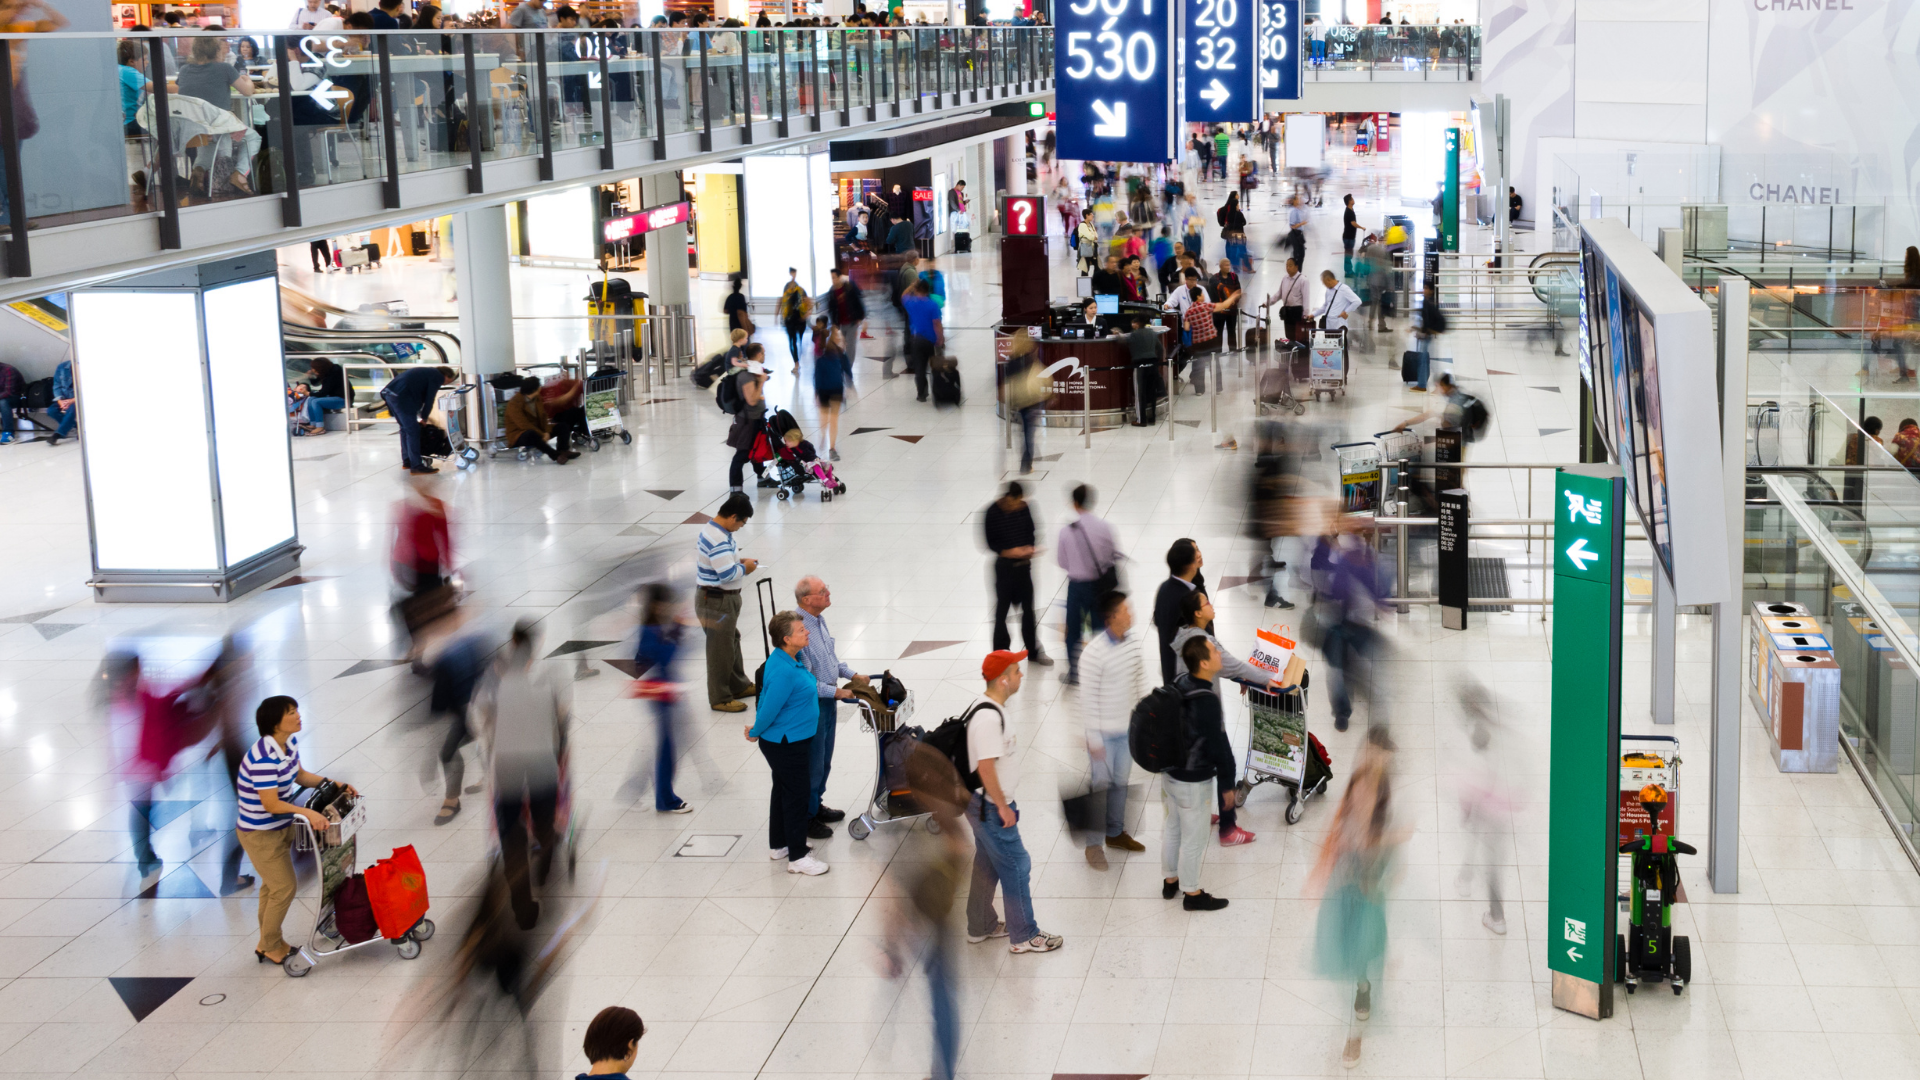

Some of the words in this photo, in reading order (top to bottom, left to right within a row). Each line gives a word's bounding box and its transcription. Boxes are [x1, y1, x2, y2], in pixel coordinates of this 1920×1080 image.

[1195, 0, 1237, 27] 20
[1065, 31, 1156, 81] 530
[1195, 37, 1237, 70] 32
[914, 191, 932, 200] SALE
[1749, 182, 1847, 205] CHANEL
[1648, 939, 1657, 954] 5
